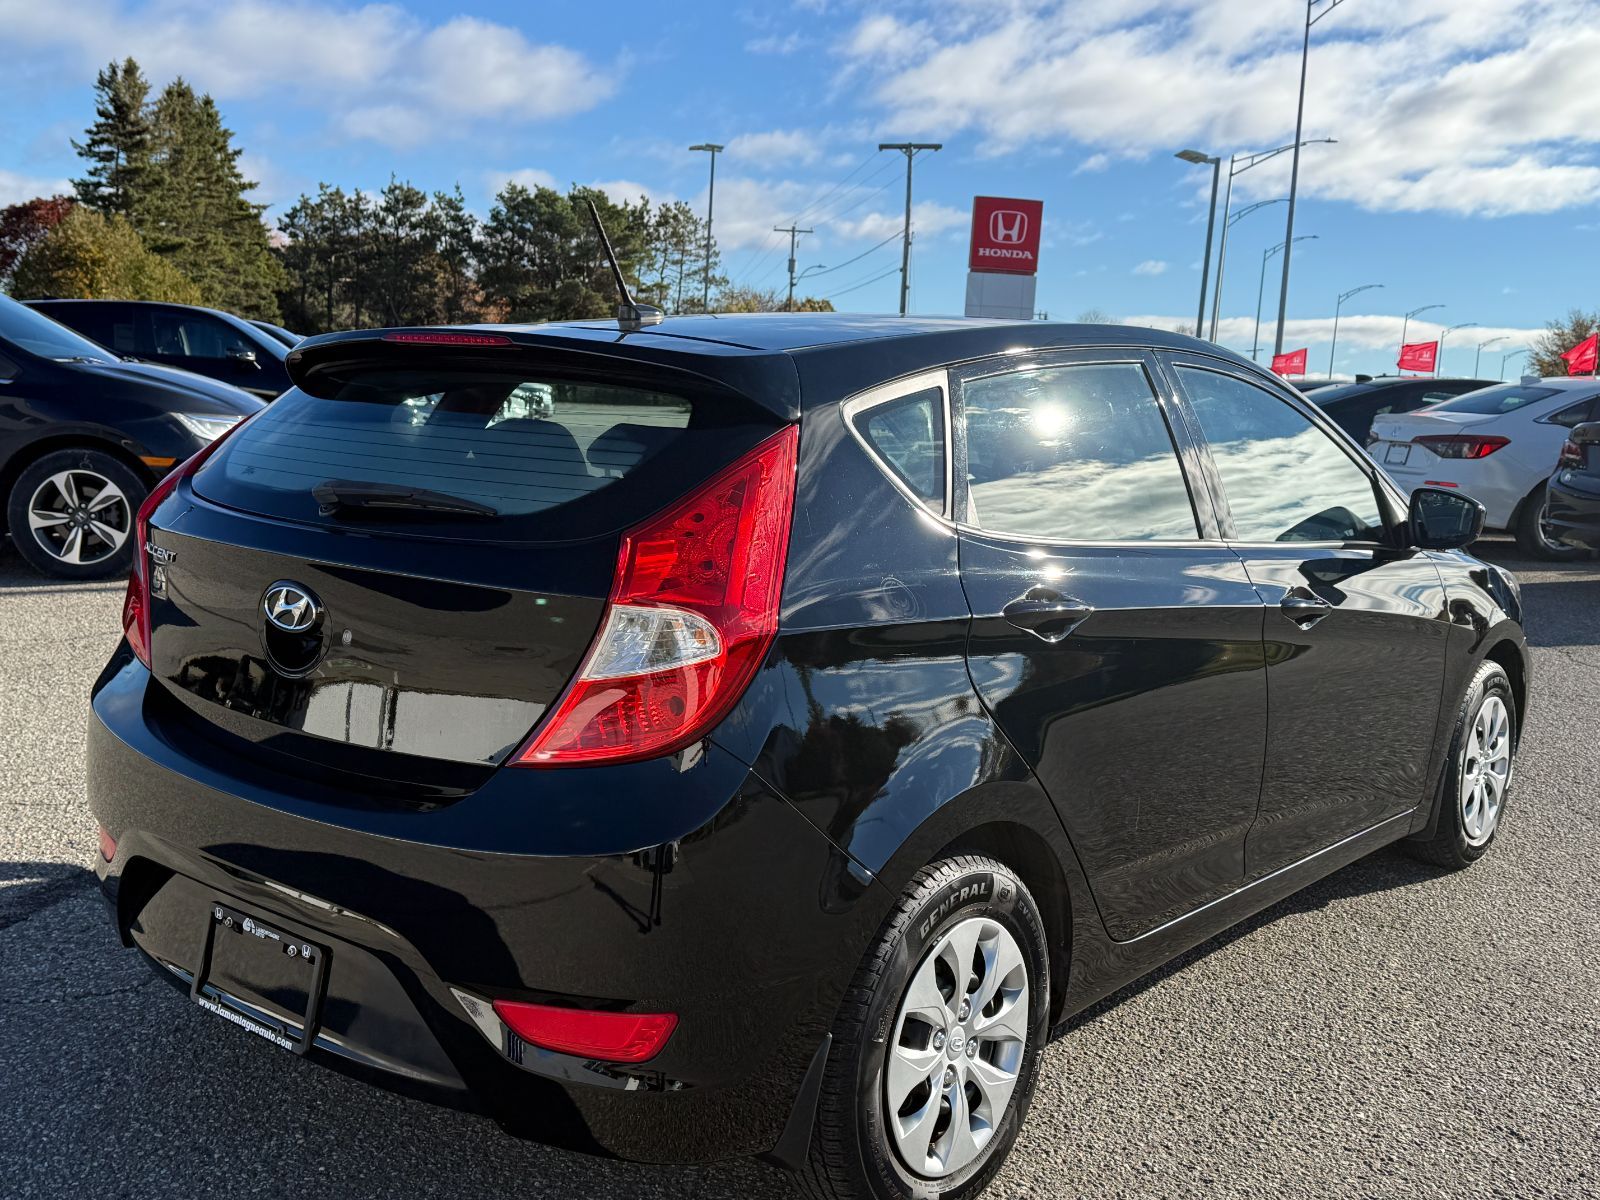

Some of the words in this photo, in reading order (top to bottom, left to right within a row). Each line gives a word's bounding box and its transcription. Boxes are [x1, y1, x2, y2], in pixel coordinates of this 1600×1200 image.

[978, 247, 1033, 260] HONDA
[144, 541, 177, 562] ACCENT
[919, 882, 989, 940] GENERAL
[198, 997, 293, 1051] www.lamontagneauto.com
